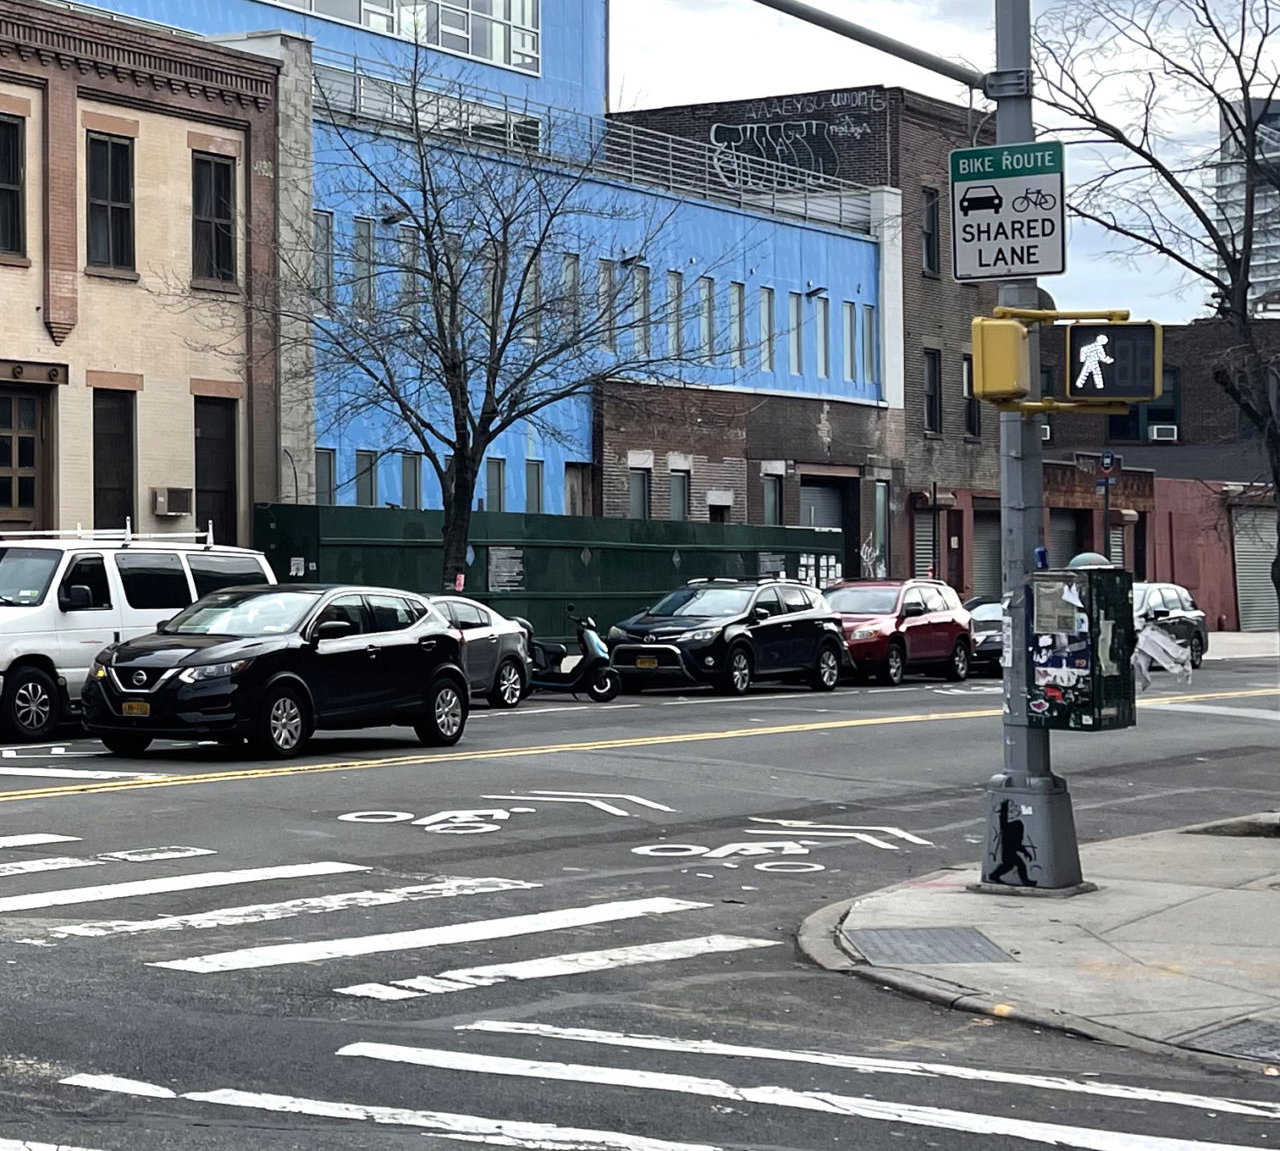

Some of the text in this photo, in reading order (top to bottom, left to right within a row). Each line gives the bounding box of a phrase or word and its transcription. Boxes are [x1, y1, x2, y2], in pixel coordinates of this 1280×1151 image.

[959, 151, 1055, 174] BIKE ROUTE
[961, 218, 1056, 243] SHARED
[978, 245, 1040, 268] LANE
